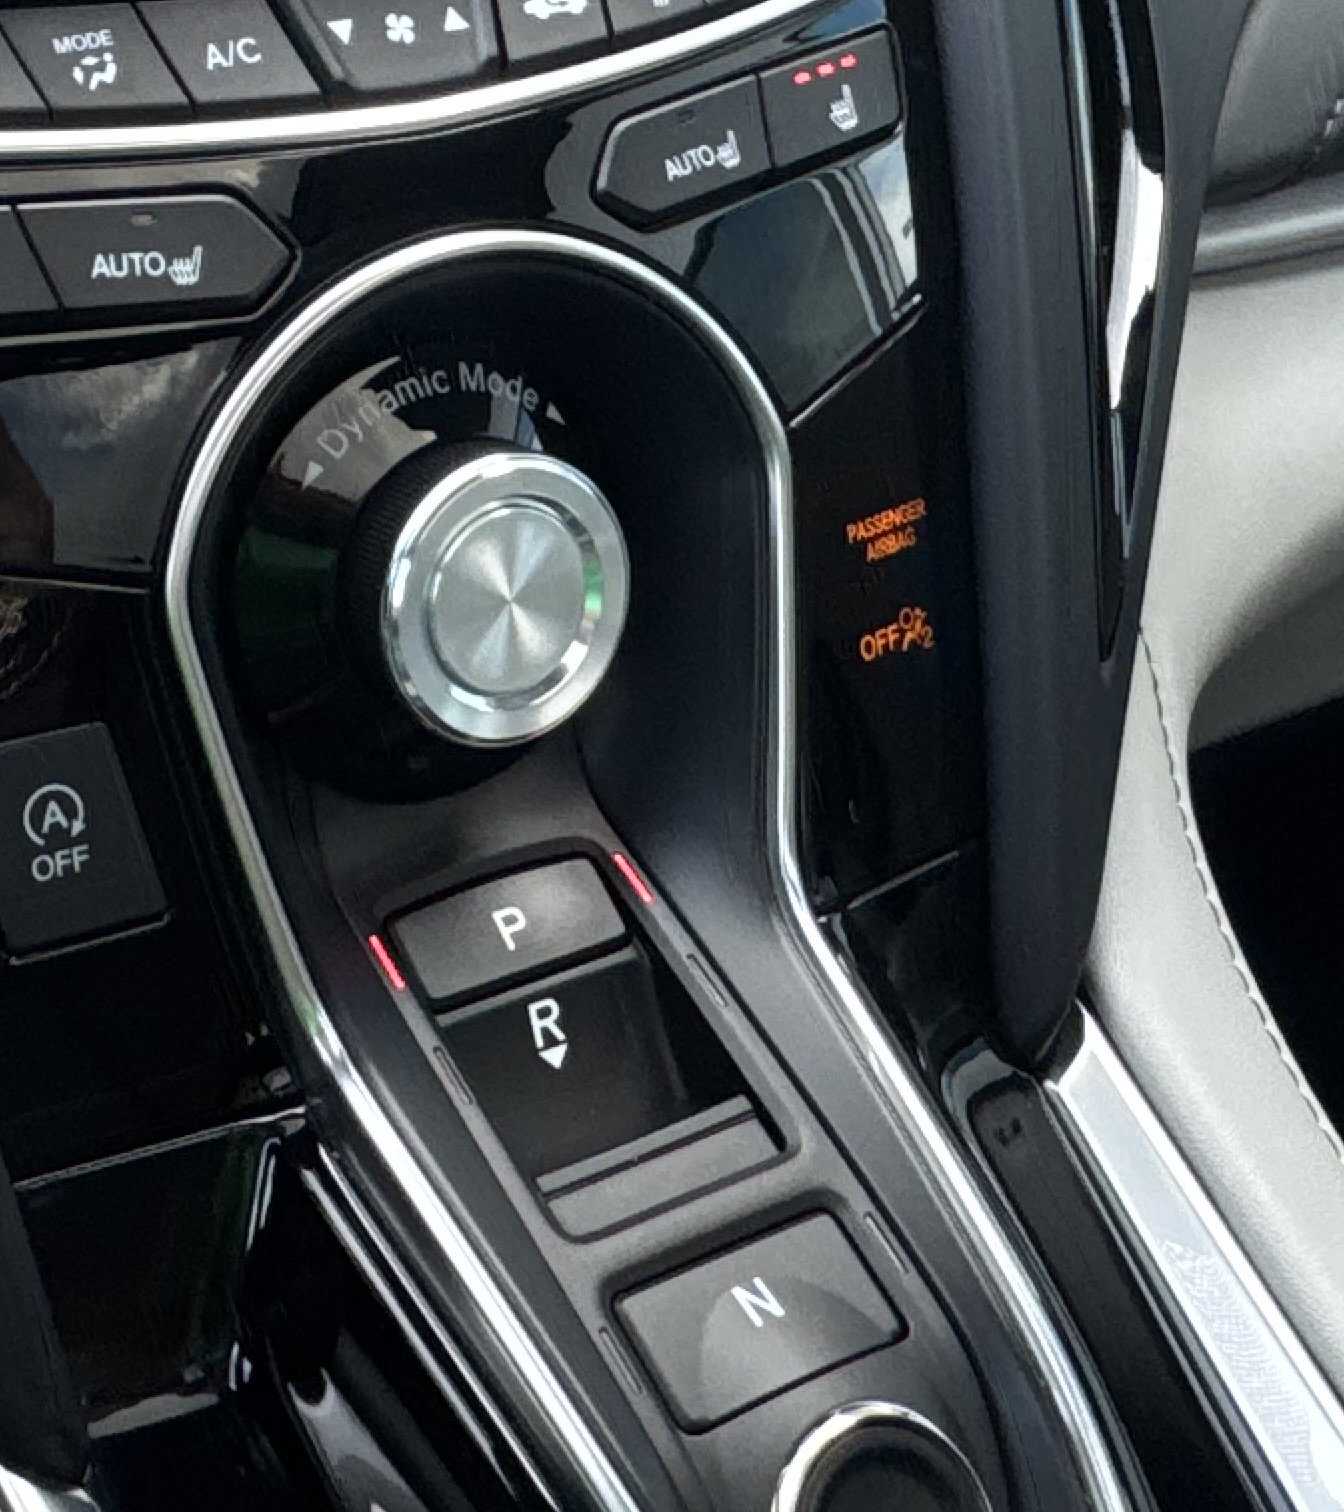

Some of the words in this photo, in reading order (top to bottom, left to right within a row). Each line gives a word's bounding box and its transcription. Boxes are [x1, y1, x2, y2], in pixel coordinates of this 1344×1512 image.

[52, 29, 114, 54] MODE
[205, 37, 262, 71] A/C
[664, 144, 715, 182] AUTO
[91, 251, 166, 280] AUTO
[316, 368, 452, 460] Dynamic
[458, 360, 540, 410] Mode
[846, 497, 927, 544] PASSENGER
[860, 621, 901, 662] OFF
[31, 843, 90, 882] OFF
[491, 906, 527, 952] P
[527, 998, 566, 1050] R
[731, 1276, 786, 1328] N
